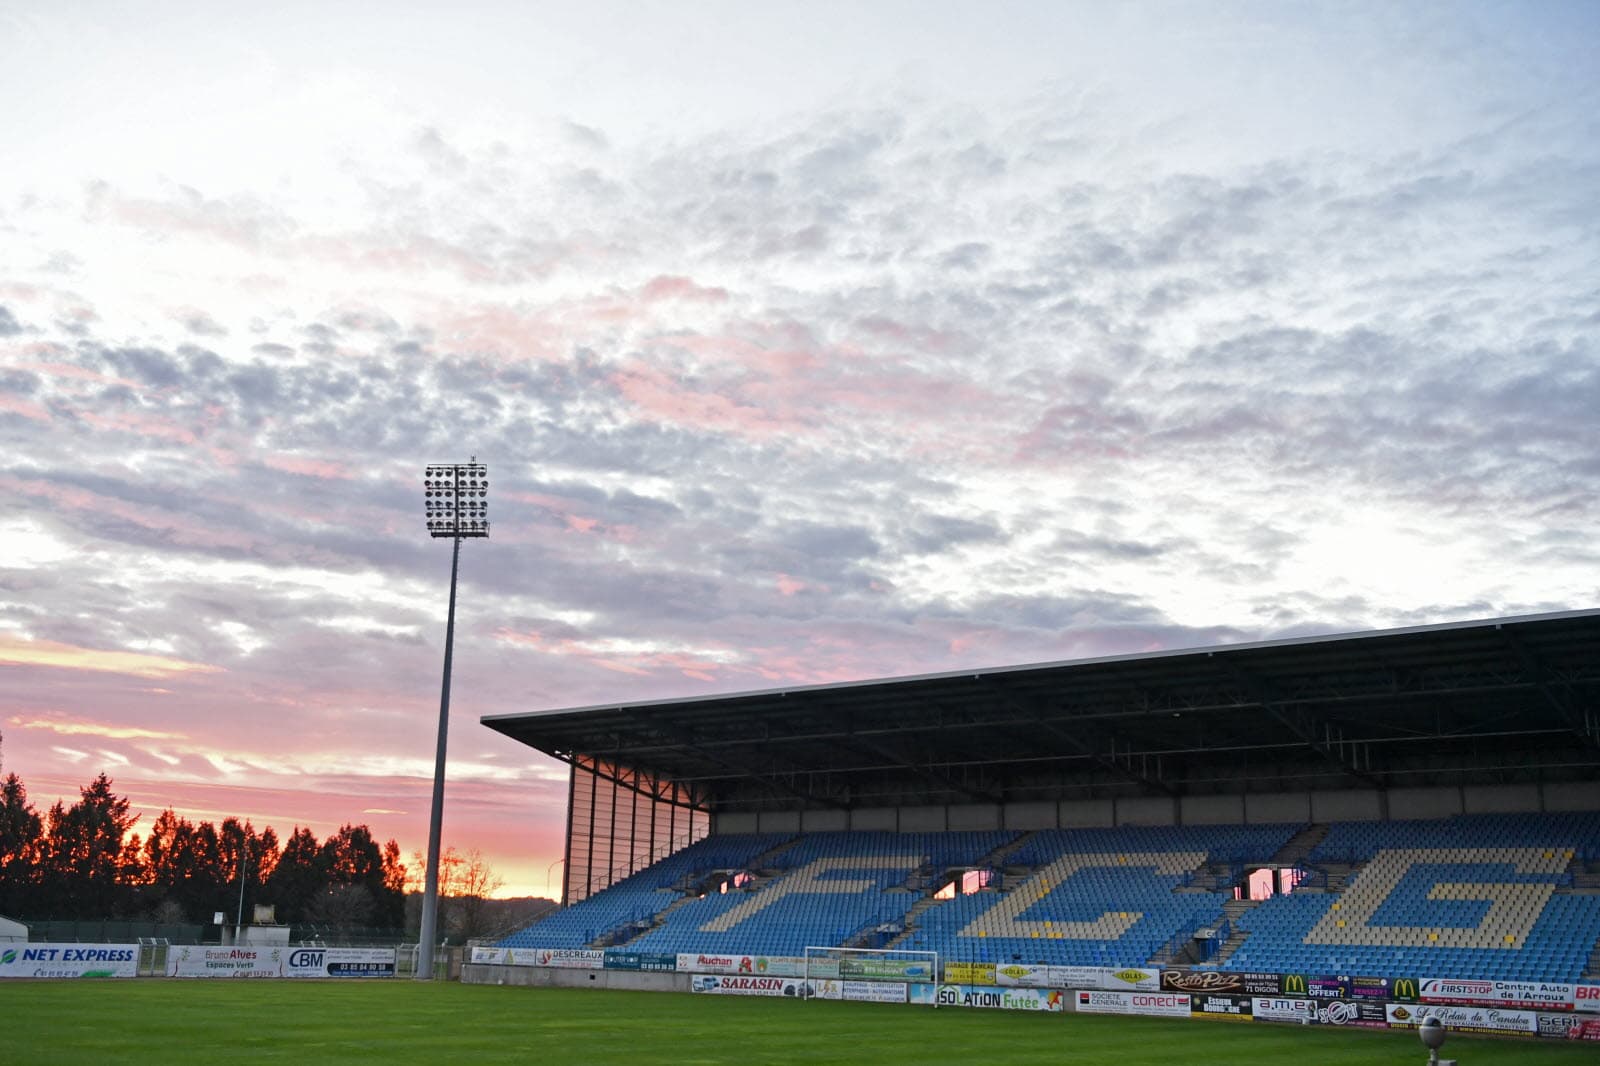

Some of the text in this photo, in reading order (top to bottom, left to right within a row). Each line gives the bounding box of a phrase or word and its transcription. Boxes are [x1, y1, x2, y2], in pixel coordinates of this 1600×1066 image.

[22, 949, 134, 961] NET EXPRESS
[206, 950, 257, 960] Bruno Alves
[289, 949, 326, 967] CBM
[553, 951, 603, 960] DESCREAUX
[697, 954, 732, 966] Auchan
[206, 961, 254, 969] Espaces Verts
[1005, 968, 1024, 976] COLAS
[1121, 972, 1142, 980] COLAS
[721, 977, 784, 990] SARASIN
[1495, 982, 1569, 993] Centre Auto
[1308, 989, 1339, 997] OFFERT
[1441, 985, 1492, 994] FIRSTSTOP
[1003, 993, 1039, 1009] Futée
[1518, 992, 1565, 1001] l'Arroux
[1434, 1008, 1467, 1020] Relais
[1471, 1012, 1482, 1022] du
[1486, 1008, 1529, 1025] Canalou
